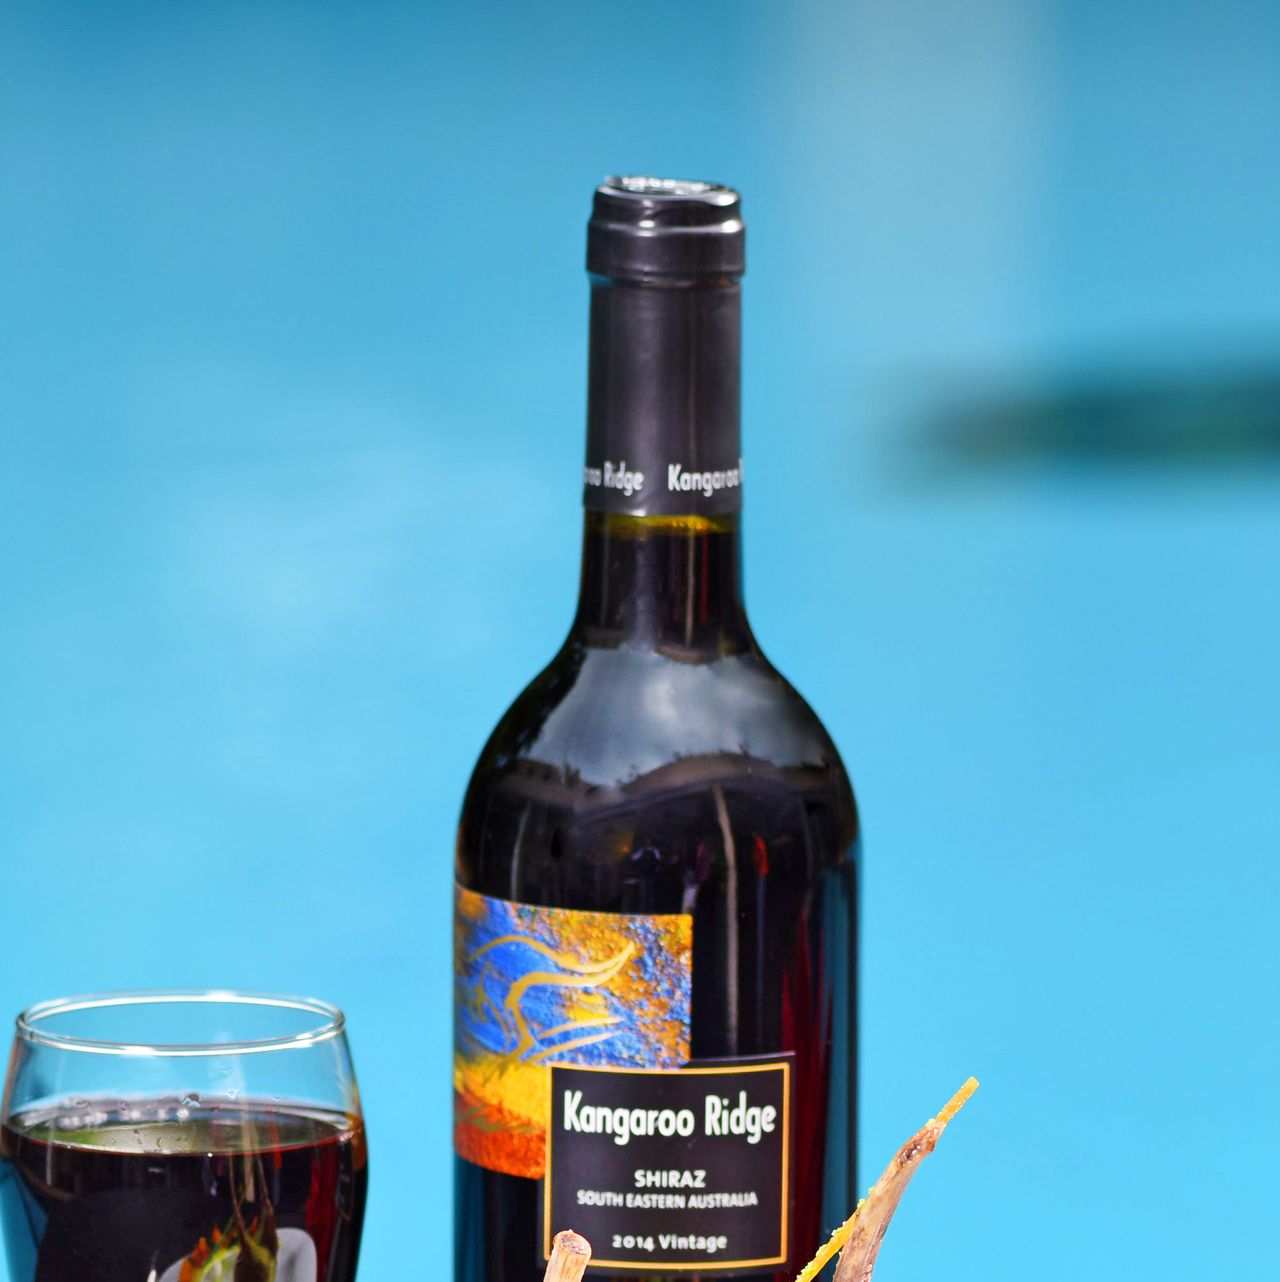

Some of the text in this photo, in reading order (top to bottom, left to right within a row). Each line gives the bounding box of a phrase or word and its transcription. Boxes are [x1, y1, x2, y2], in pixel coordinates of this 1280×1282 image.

[603, 461, 645, 497] Ridge
[667, 463, 739, 498] Kangaroo
[564, 1090, 777, 1146] Kangaroo Ridge
[634, 1169, 707, 1188] SHIRAZ
[577, 1190, 758, 1208] SOUTH EASTERN AUSTRALIA
[612, 1234, 728, 1253] 2014 Vintage
